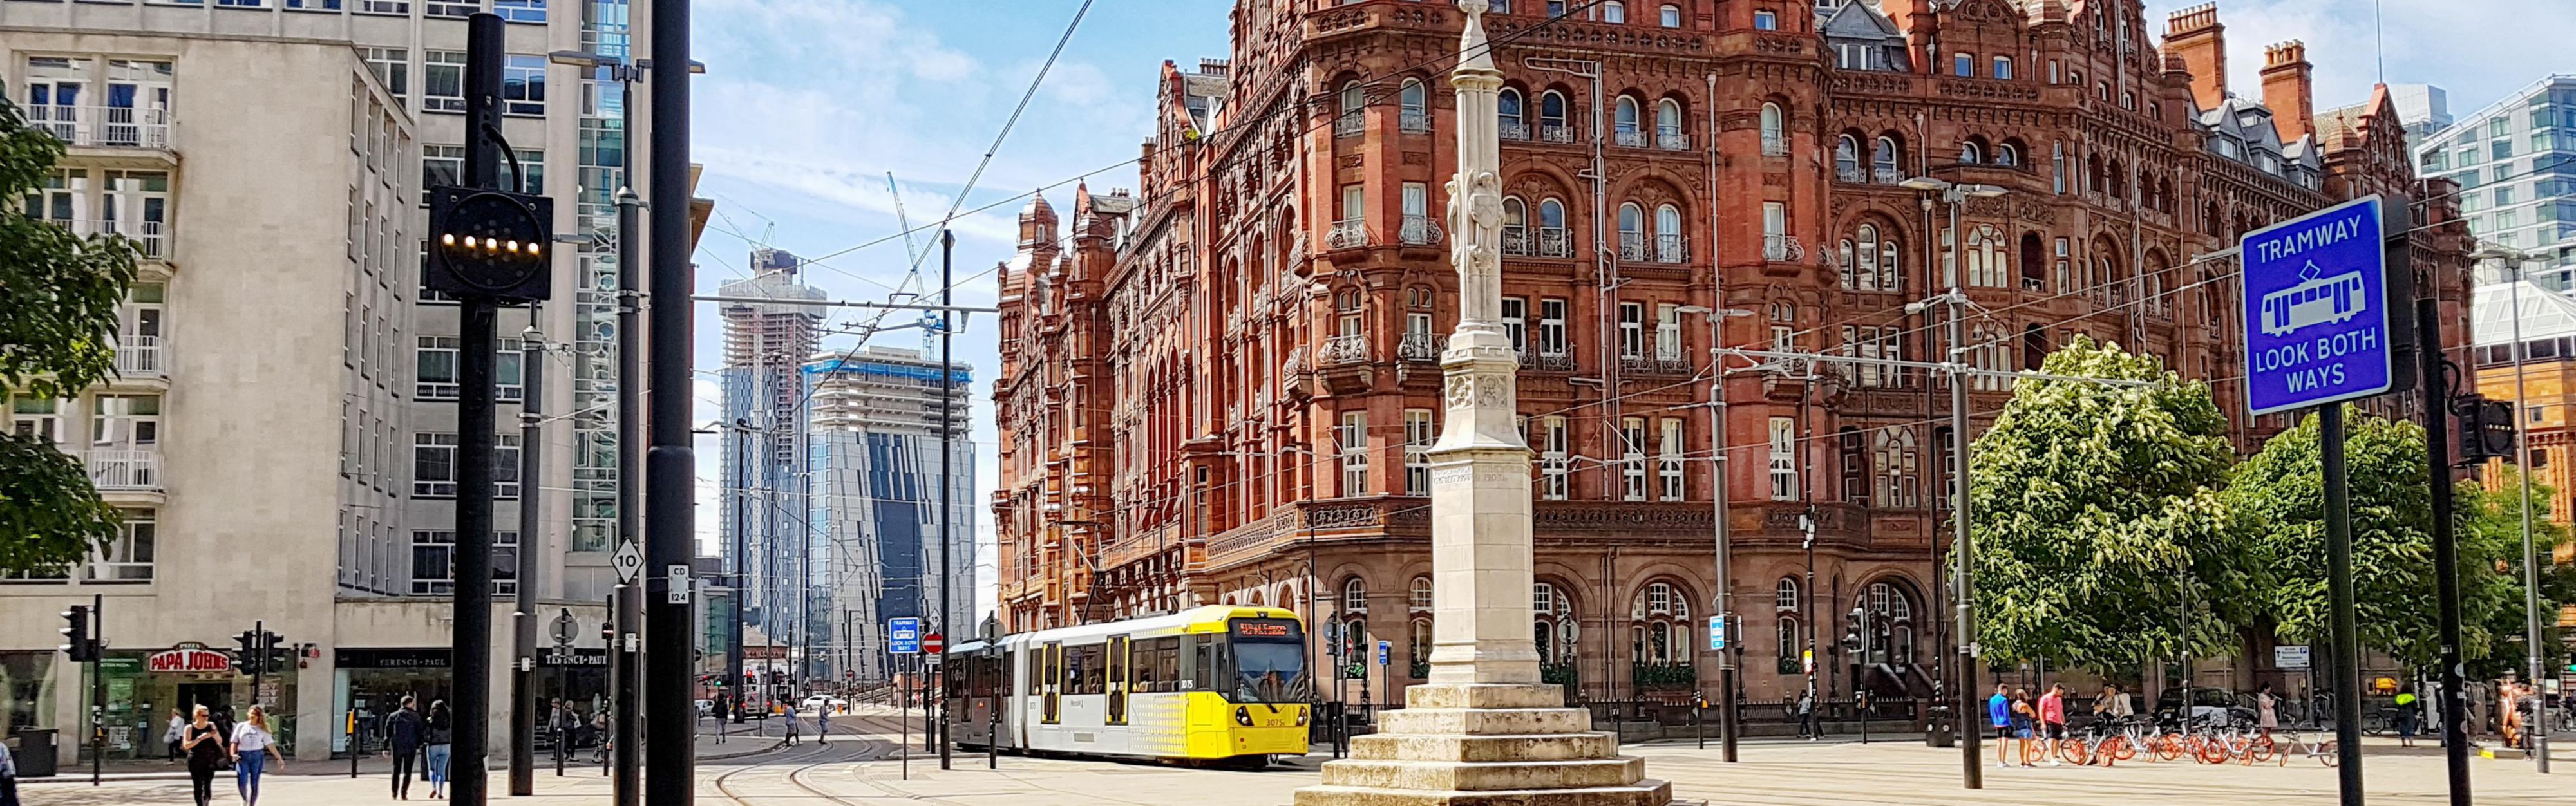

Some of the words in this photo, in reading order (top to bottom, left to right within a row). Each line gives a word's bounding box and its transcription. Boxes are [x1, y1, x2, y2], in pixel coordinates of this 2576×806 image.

[2257, 214, 2362, 263] TRAMWAY
[2255, 341, 2310, 373] LOOK
[2317, 326, 2376, 360] BOTH
[2286, 362, 2345, 393] WAYS
[618, 554, 636, 567] 10
[671, 593, 686, 601] 124
[151, 651, 184, 670] PAPA
[1181, 679, 1193, 689] 3075
